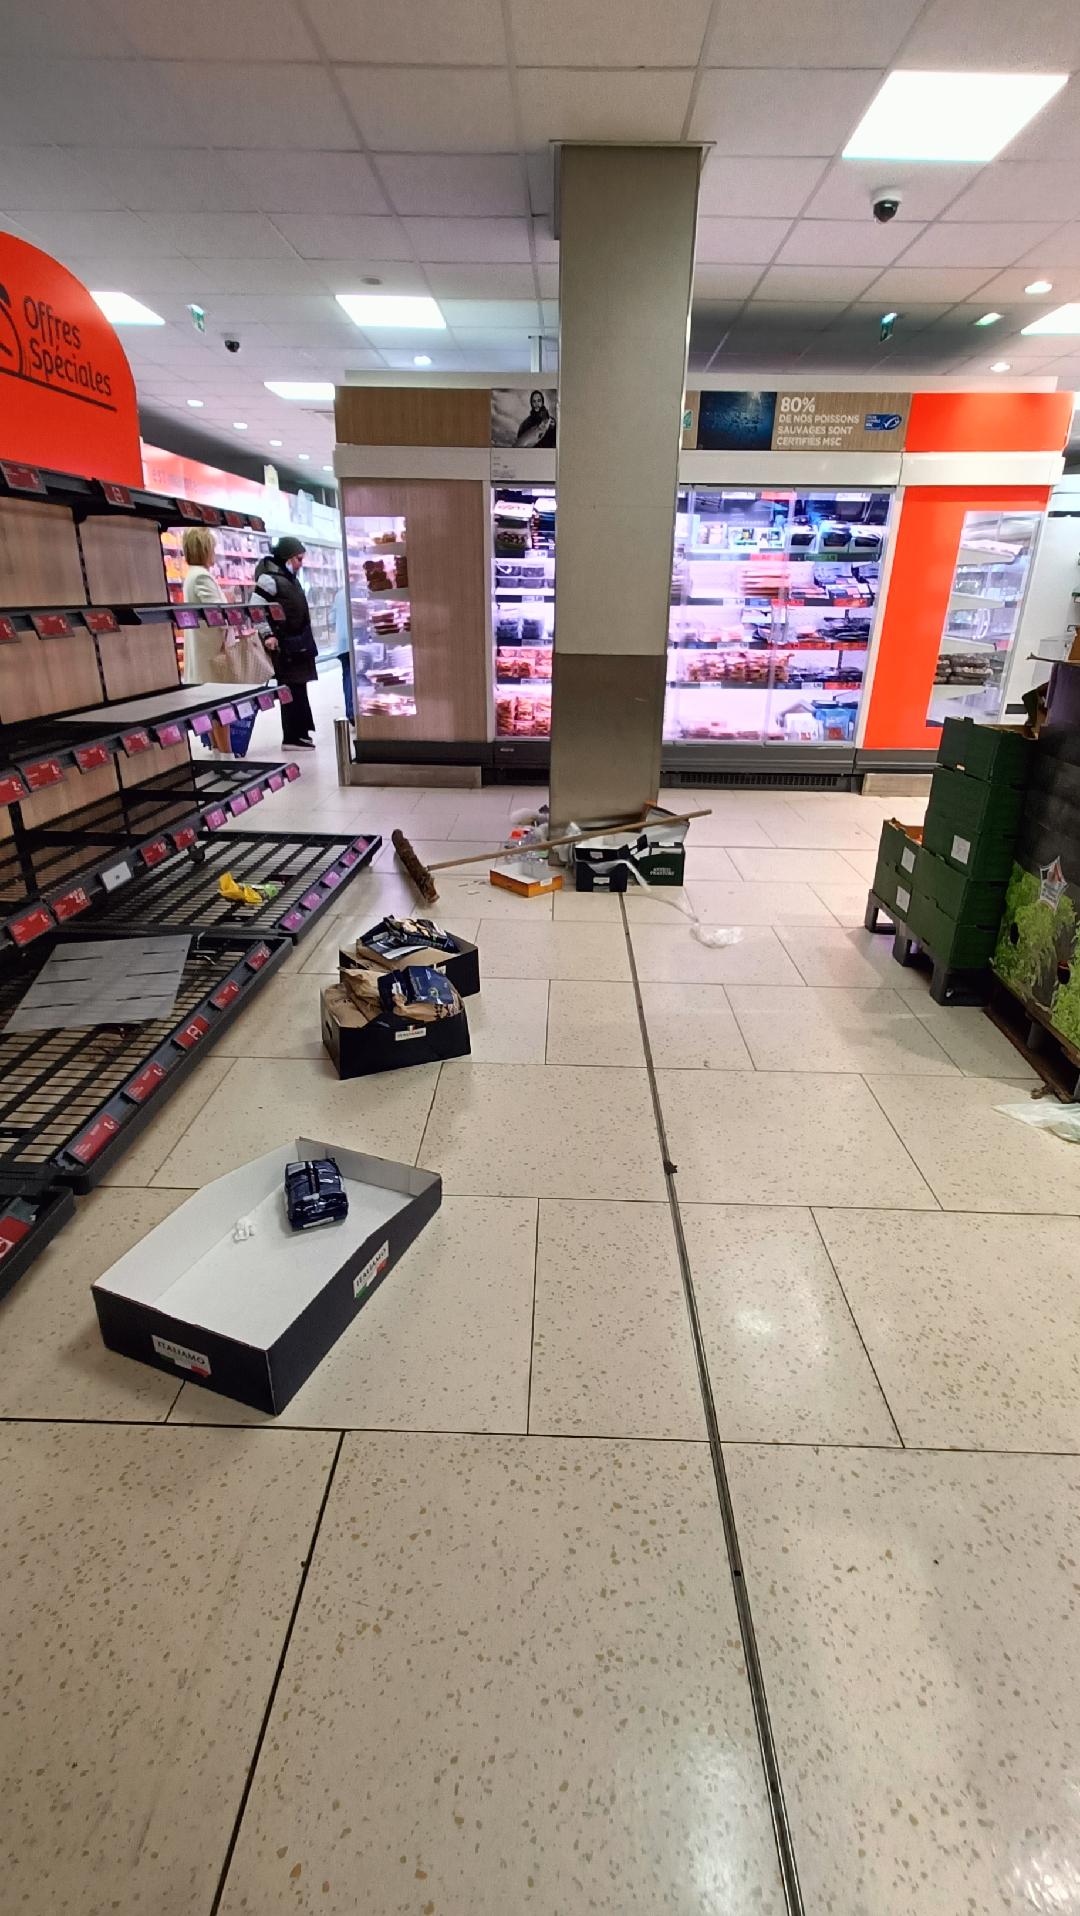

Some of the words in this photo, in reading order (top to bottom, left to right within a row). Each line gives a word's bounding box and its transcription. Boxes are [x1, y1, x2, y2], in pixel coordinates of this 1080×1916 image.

[24, 296, 81, 349] Offres
[30, 338, 111, 396] Spéciales
[780, 396, 816, 412] 80%
[779, 414, 792, 424] DE
[793, 414, 813, 424] NOS
[814, 414, 860, 424] POISSONS
[778, 425, 826, 435] SAUVAGES
[828, 425, 853, 434] SONT
[822, 437, 842, 446] MSC
